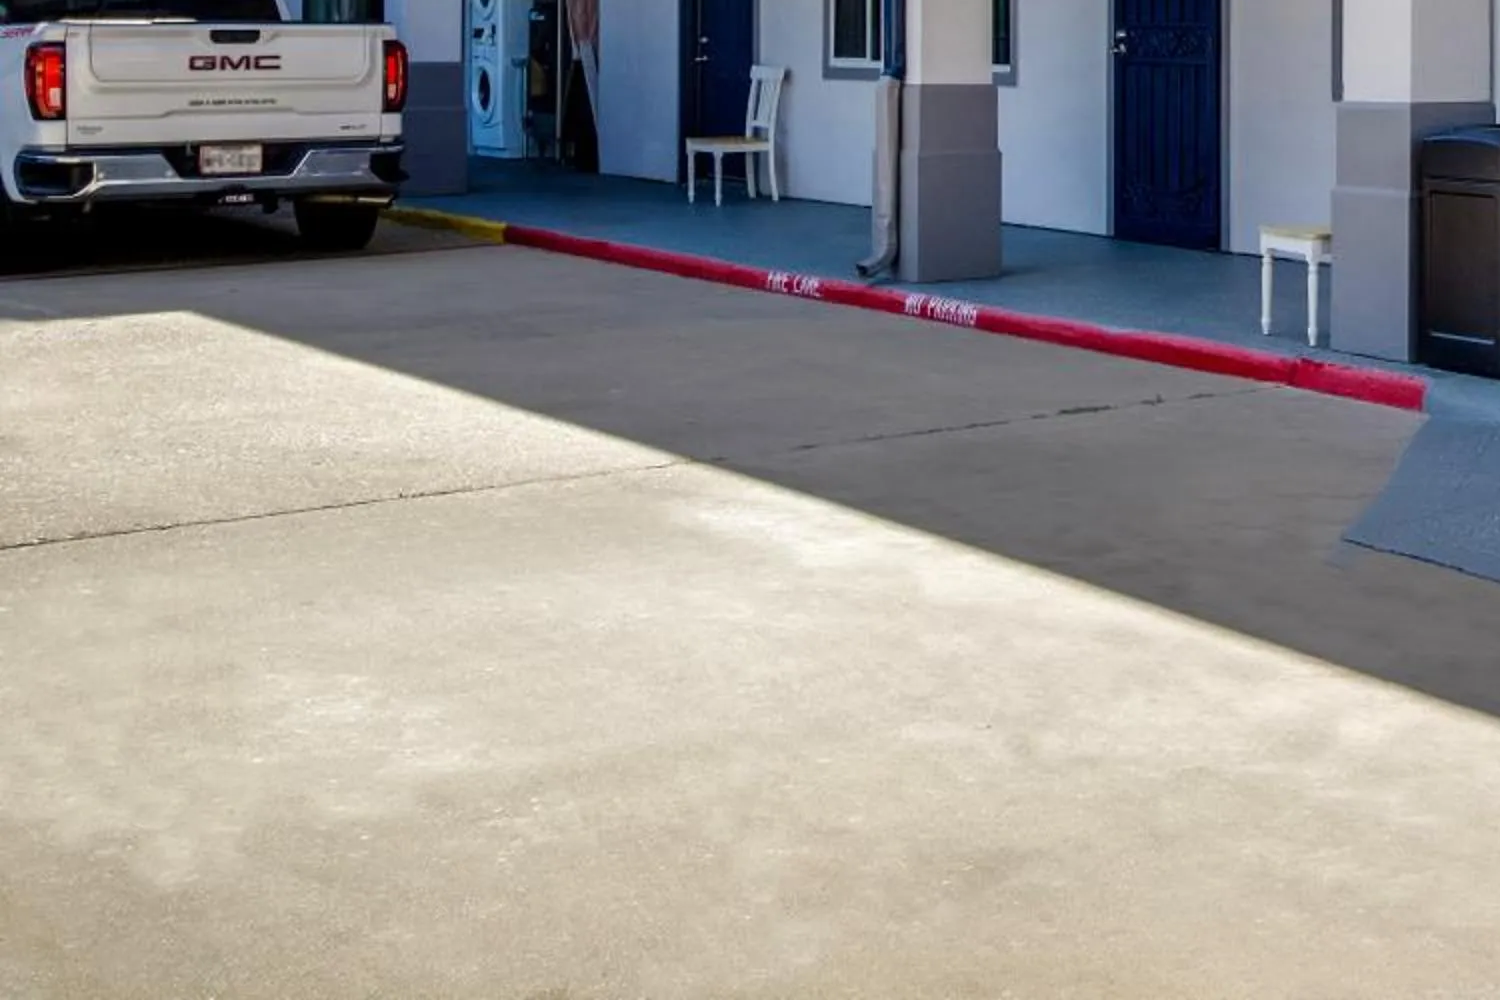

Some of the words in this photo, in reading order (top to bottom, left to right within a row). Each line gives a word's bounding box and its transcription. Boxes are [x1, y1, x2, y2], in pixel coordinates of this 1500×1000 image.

[189, 55, 281, 71] GMC
[766, 269, 790, 293] FIRE
[793, 273, 822, 298] LANE
[904, 293, 926, 315] NO
